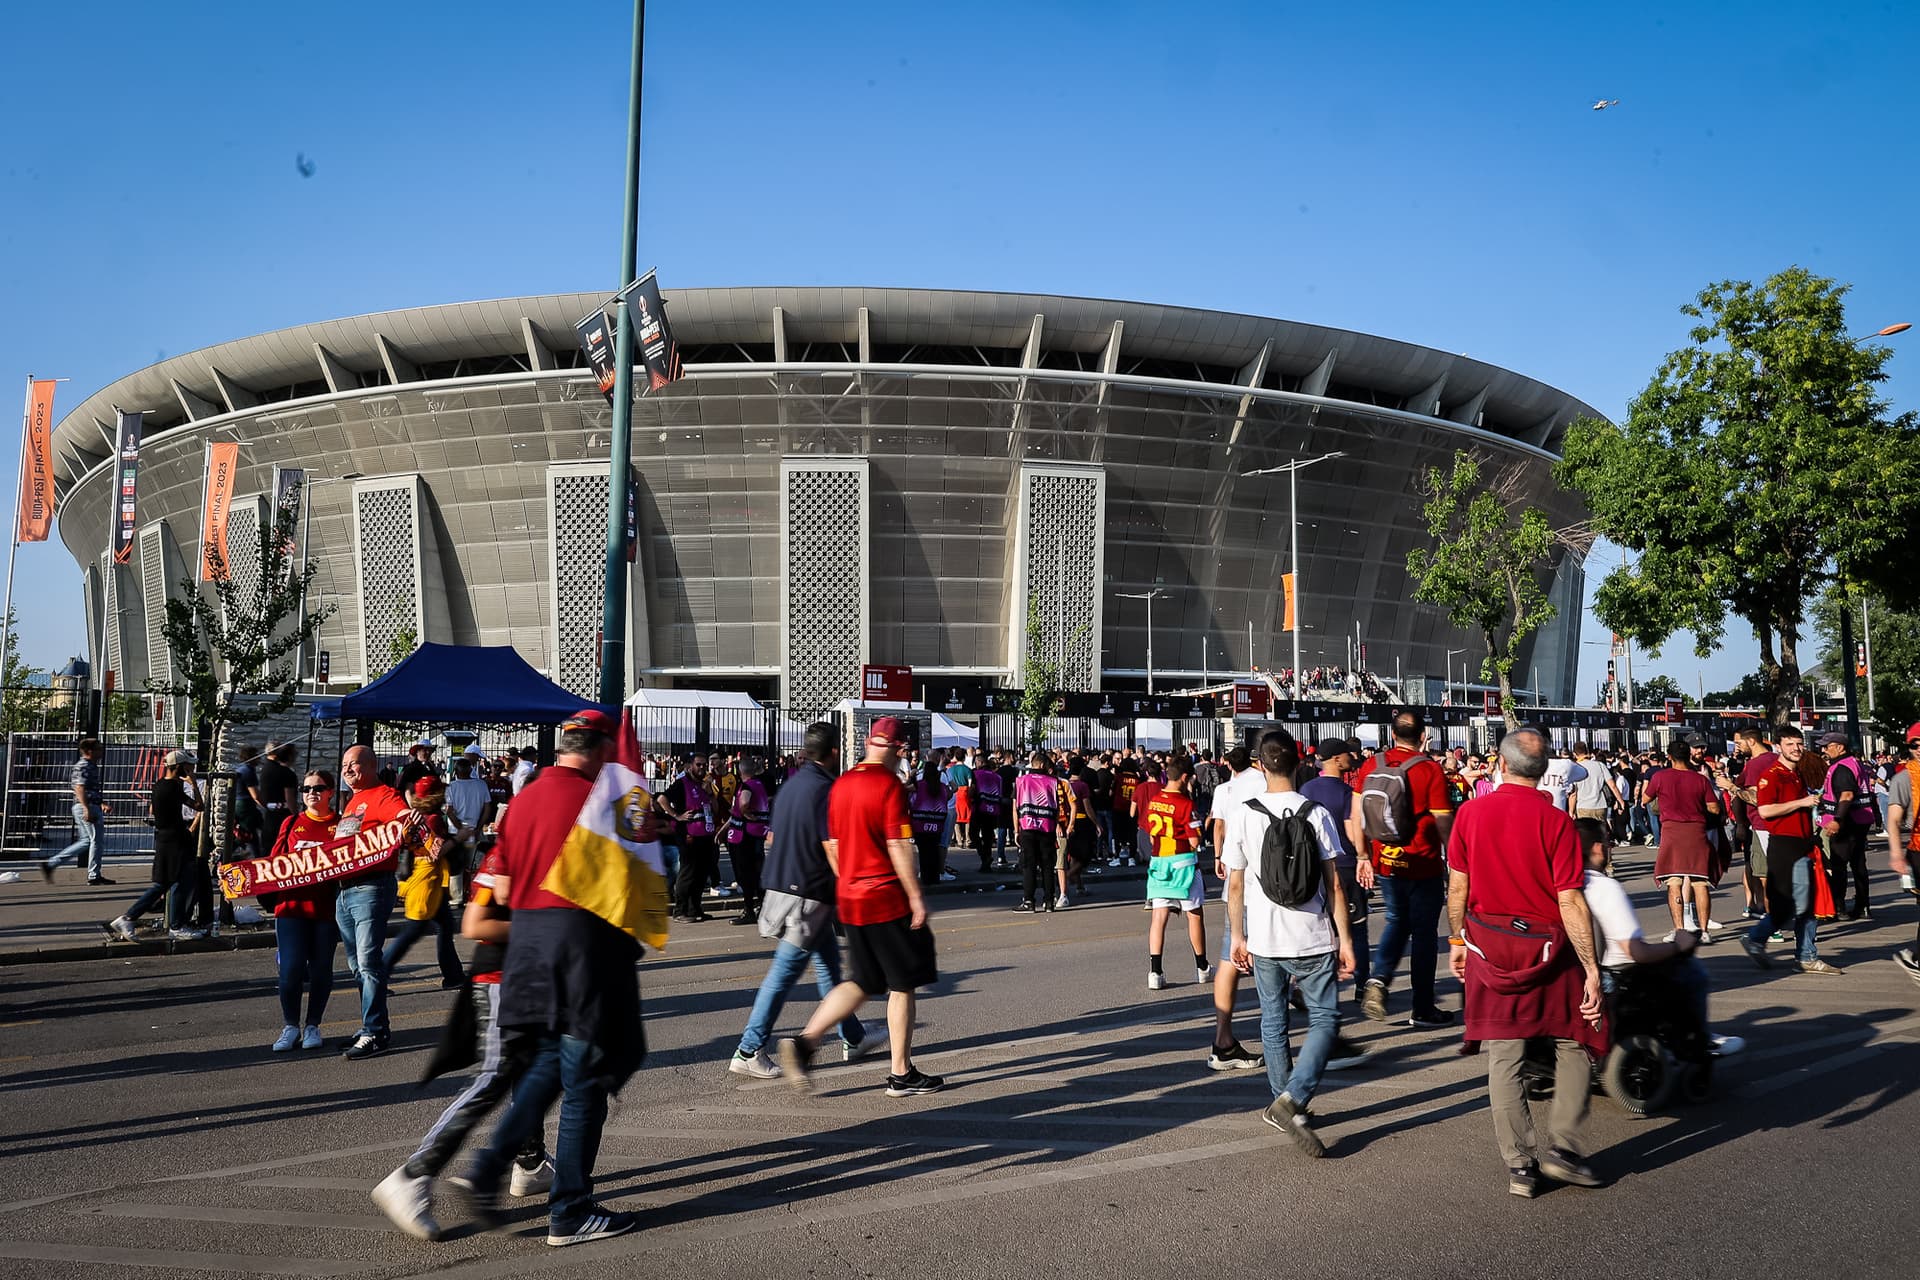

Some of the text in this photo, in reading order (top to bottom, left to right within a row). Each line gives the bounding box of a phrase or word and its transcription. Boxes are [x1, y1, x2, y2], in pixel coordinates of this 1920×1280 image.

[35, 402, 44, 433] 2023
[35, 437, 44, 474] FINAL
[216, 462, 227, 488] 2023
[212, 490, 223, 521] FINAL
[1026, 817, 1043, 828] 717
[1148, 813, 1174, 838] 21
[251, 845, 333, 883] ROMA
[334, 845, 352, 864] TI
[351, 821, 403, 858] AMO
[277, 850, 389, 889] unico grande amore
